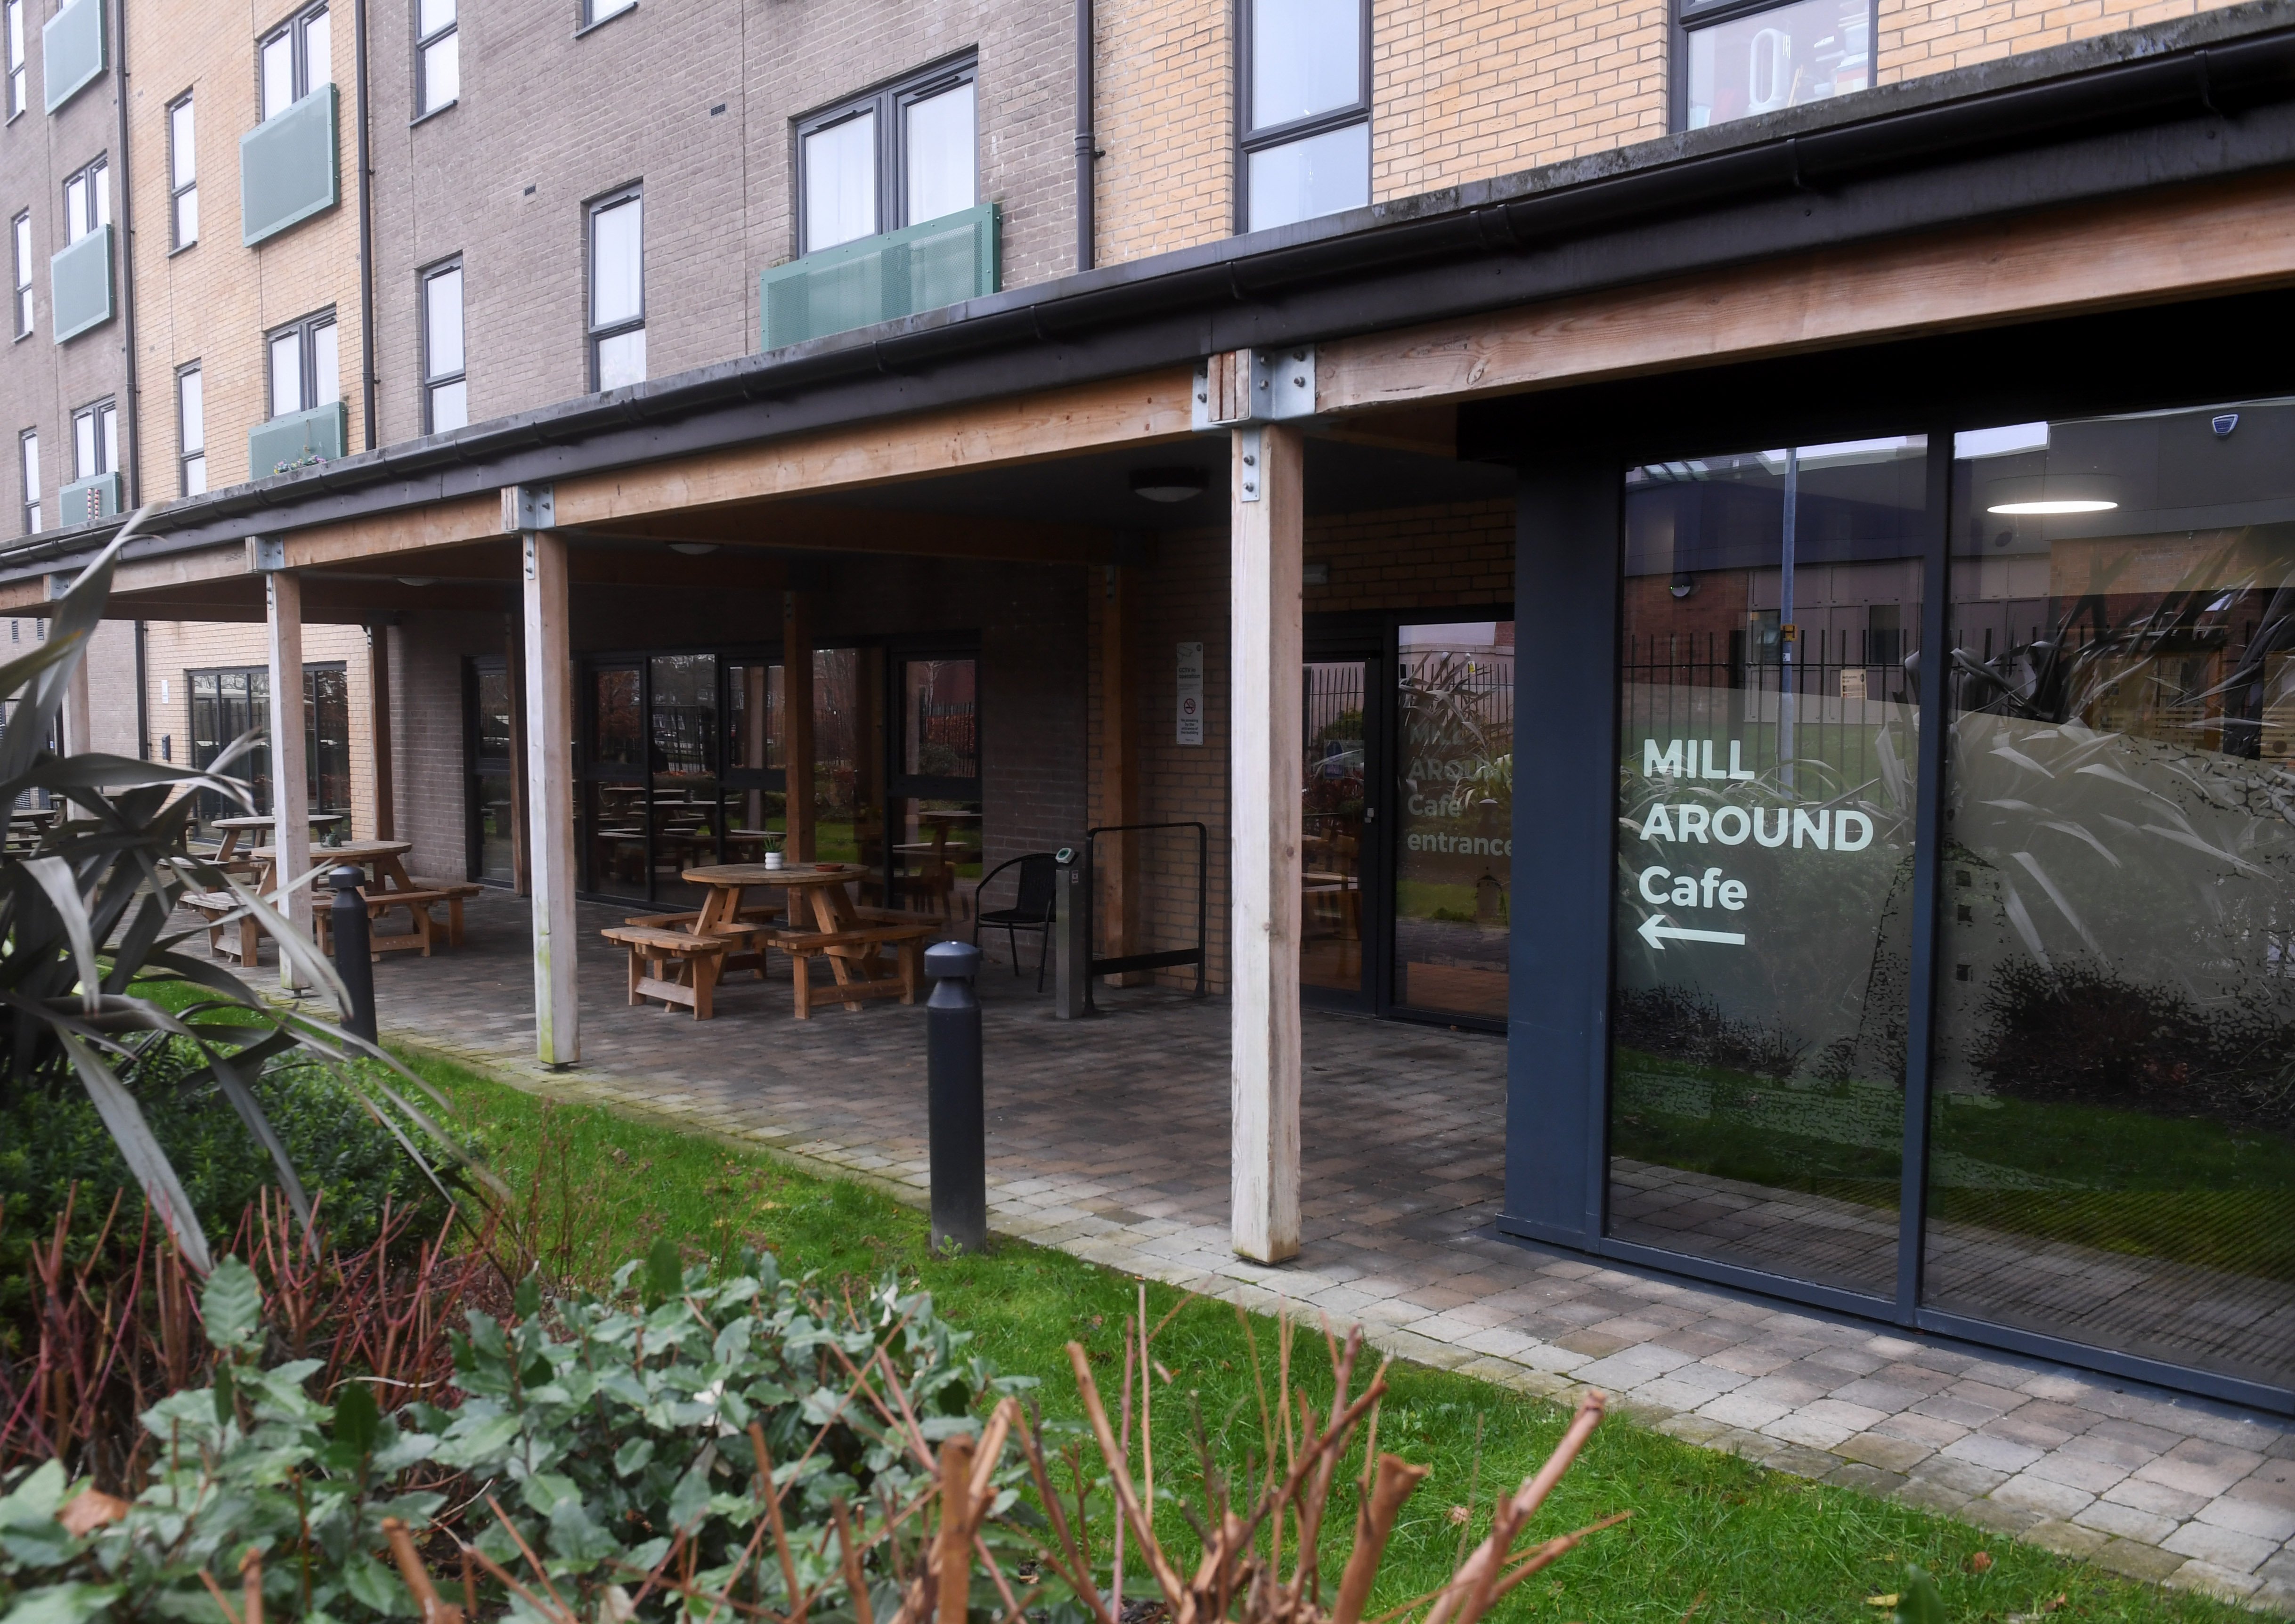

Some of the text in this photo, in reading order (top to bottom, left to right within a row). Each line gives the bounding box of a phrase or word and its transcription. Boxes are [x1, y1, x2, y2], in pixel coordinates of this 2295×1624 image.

[1643, 739, 1755, 780] MILL
[1639, 803, 1874, 852] AROUND
[1638, 866, 1748, 910] Cafe
